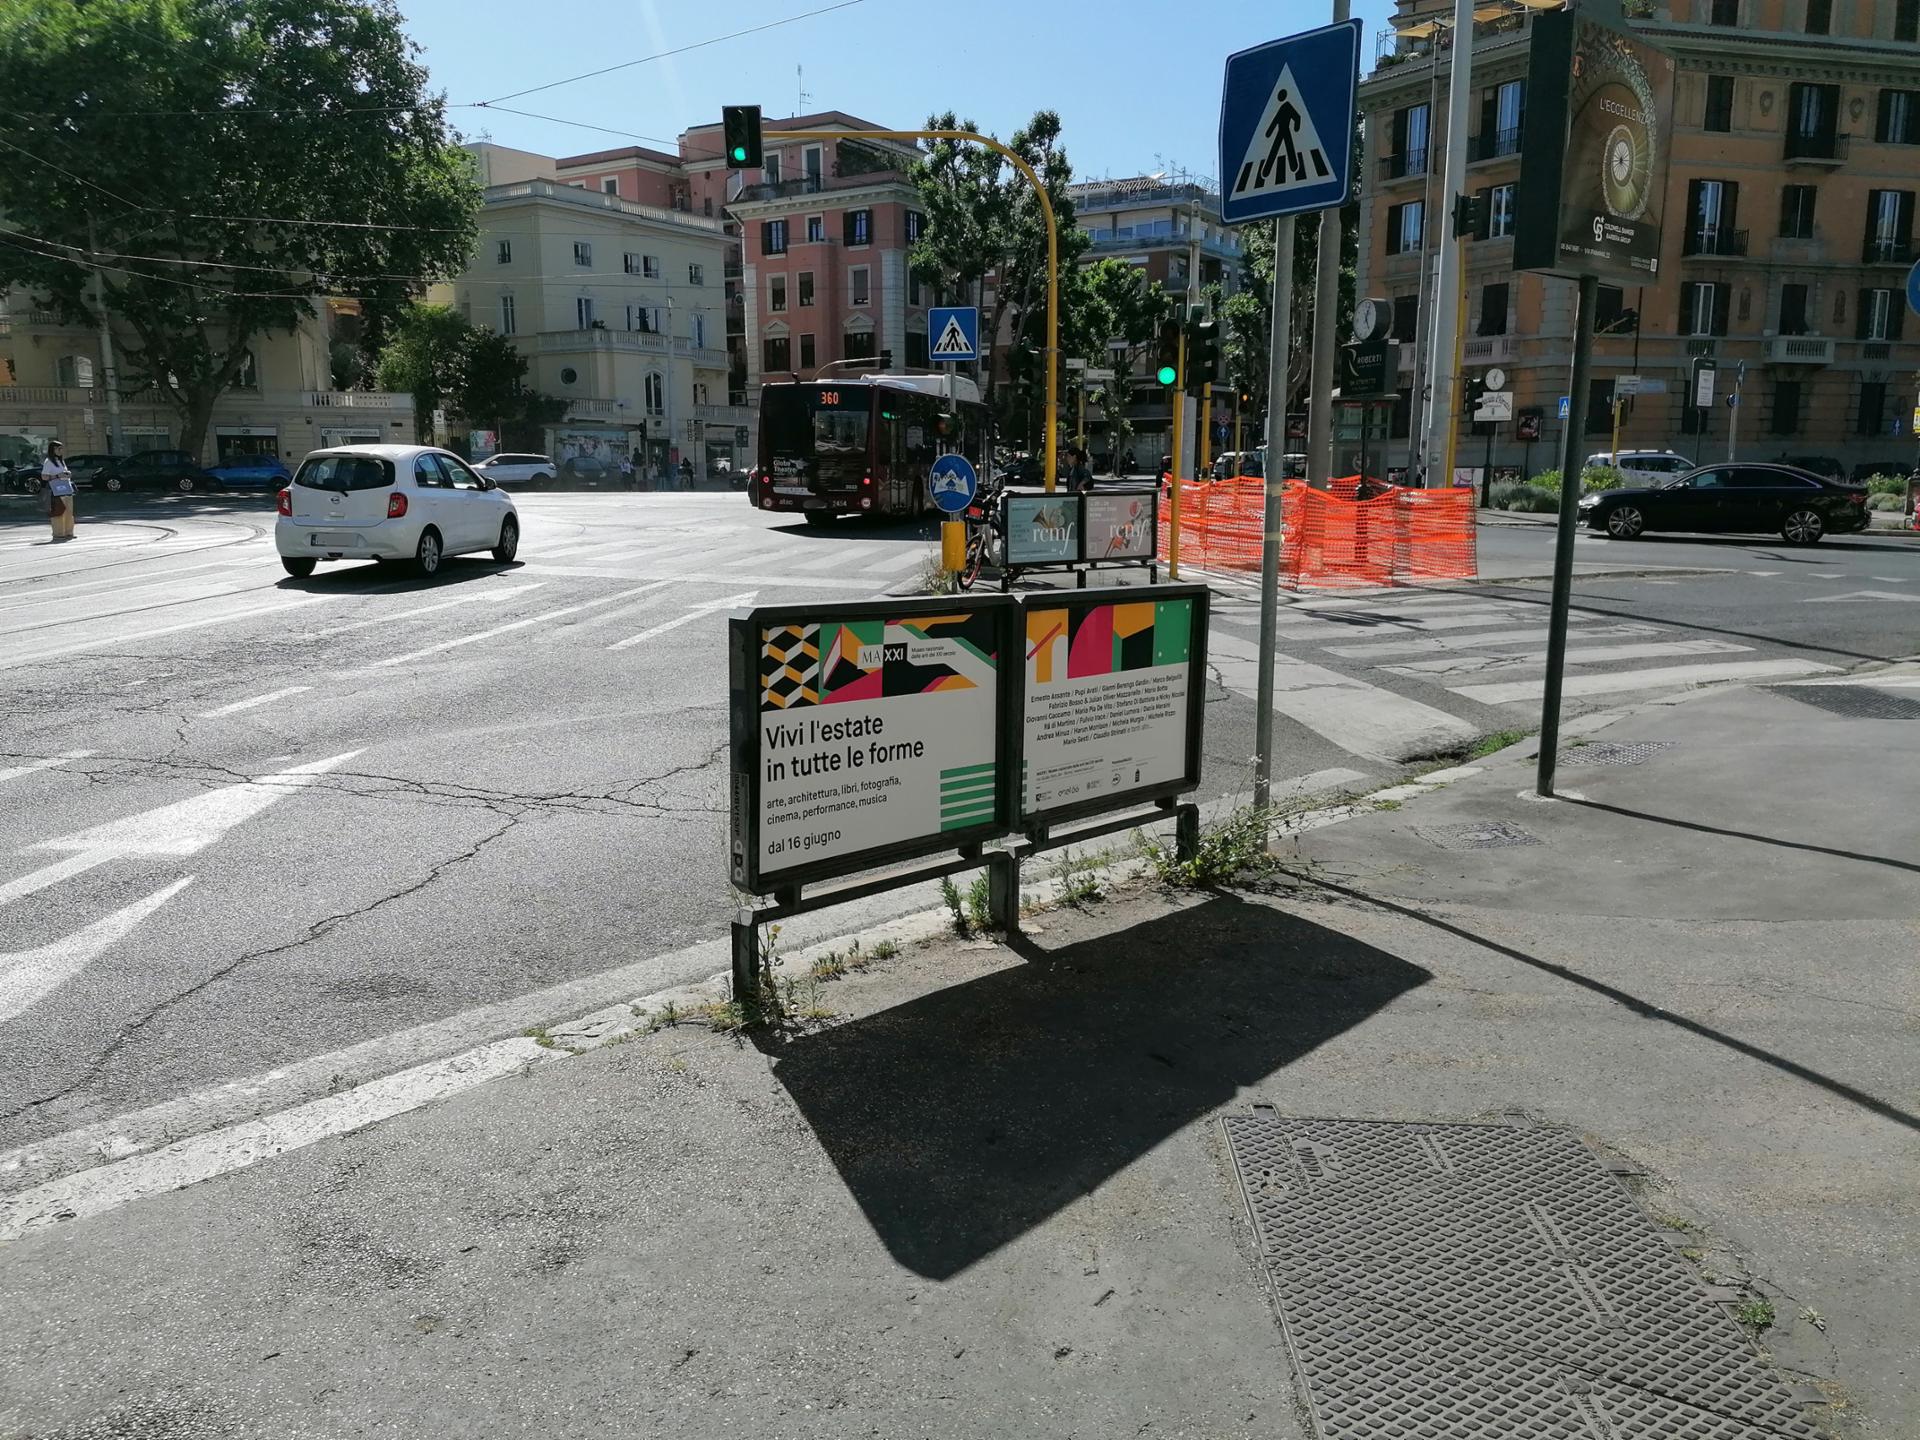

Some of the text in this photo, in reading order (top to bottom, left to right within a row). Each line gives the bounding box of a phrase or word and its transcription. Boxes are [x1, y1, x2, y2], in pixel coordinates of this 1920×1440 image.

[821, 392, 839, 405] 360
[1032, 522, 1074, 556] rcmf
[1110, 519, 1148, 552] rcmf
[766, 714, 884, 750] Vivi l'estate
[767, 740, 924, 782] in tutte le forme
[766, 776, 902, 810] arte, architettura, libri, fotografia,
[766, 793, 888, 826] cinema, performance, musica
[768, 829, 842, 856] dal 16 giugno
